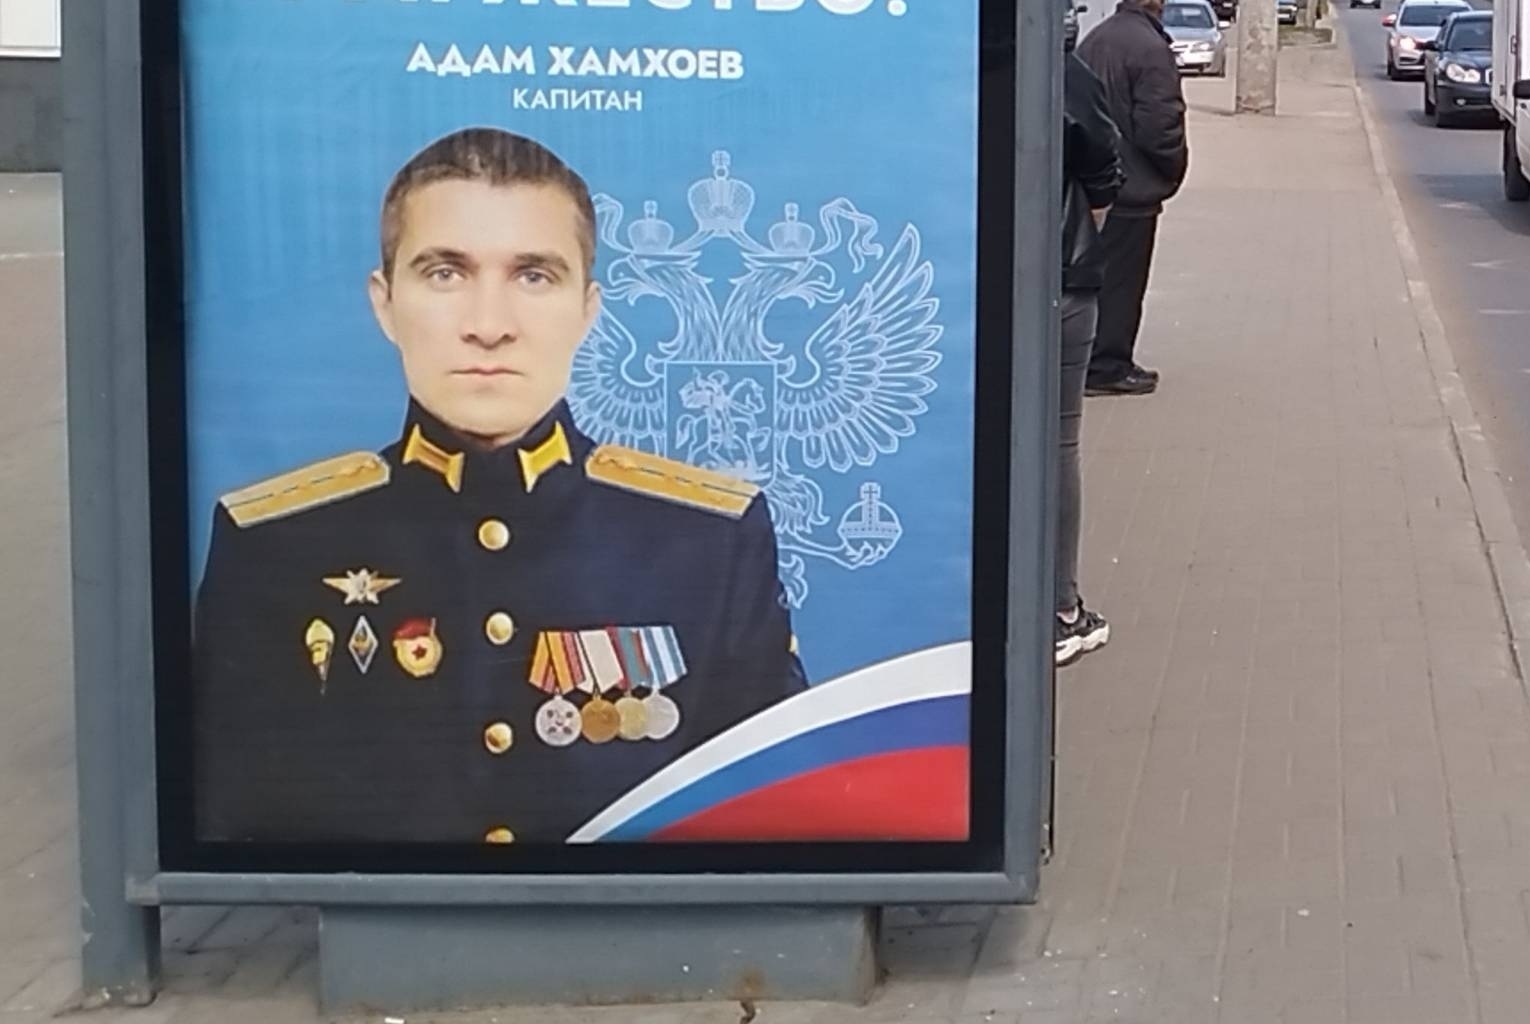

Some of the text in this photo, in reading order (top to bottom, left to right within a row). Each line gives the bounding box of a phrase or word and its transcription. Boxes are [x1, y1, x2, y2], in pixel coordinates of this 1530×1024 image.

[405, 42, 745, 81] АДАМ ХАМХОЕВ
[512, 87, 644, 113] КАПИТАН
